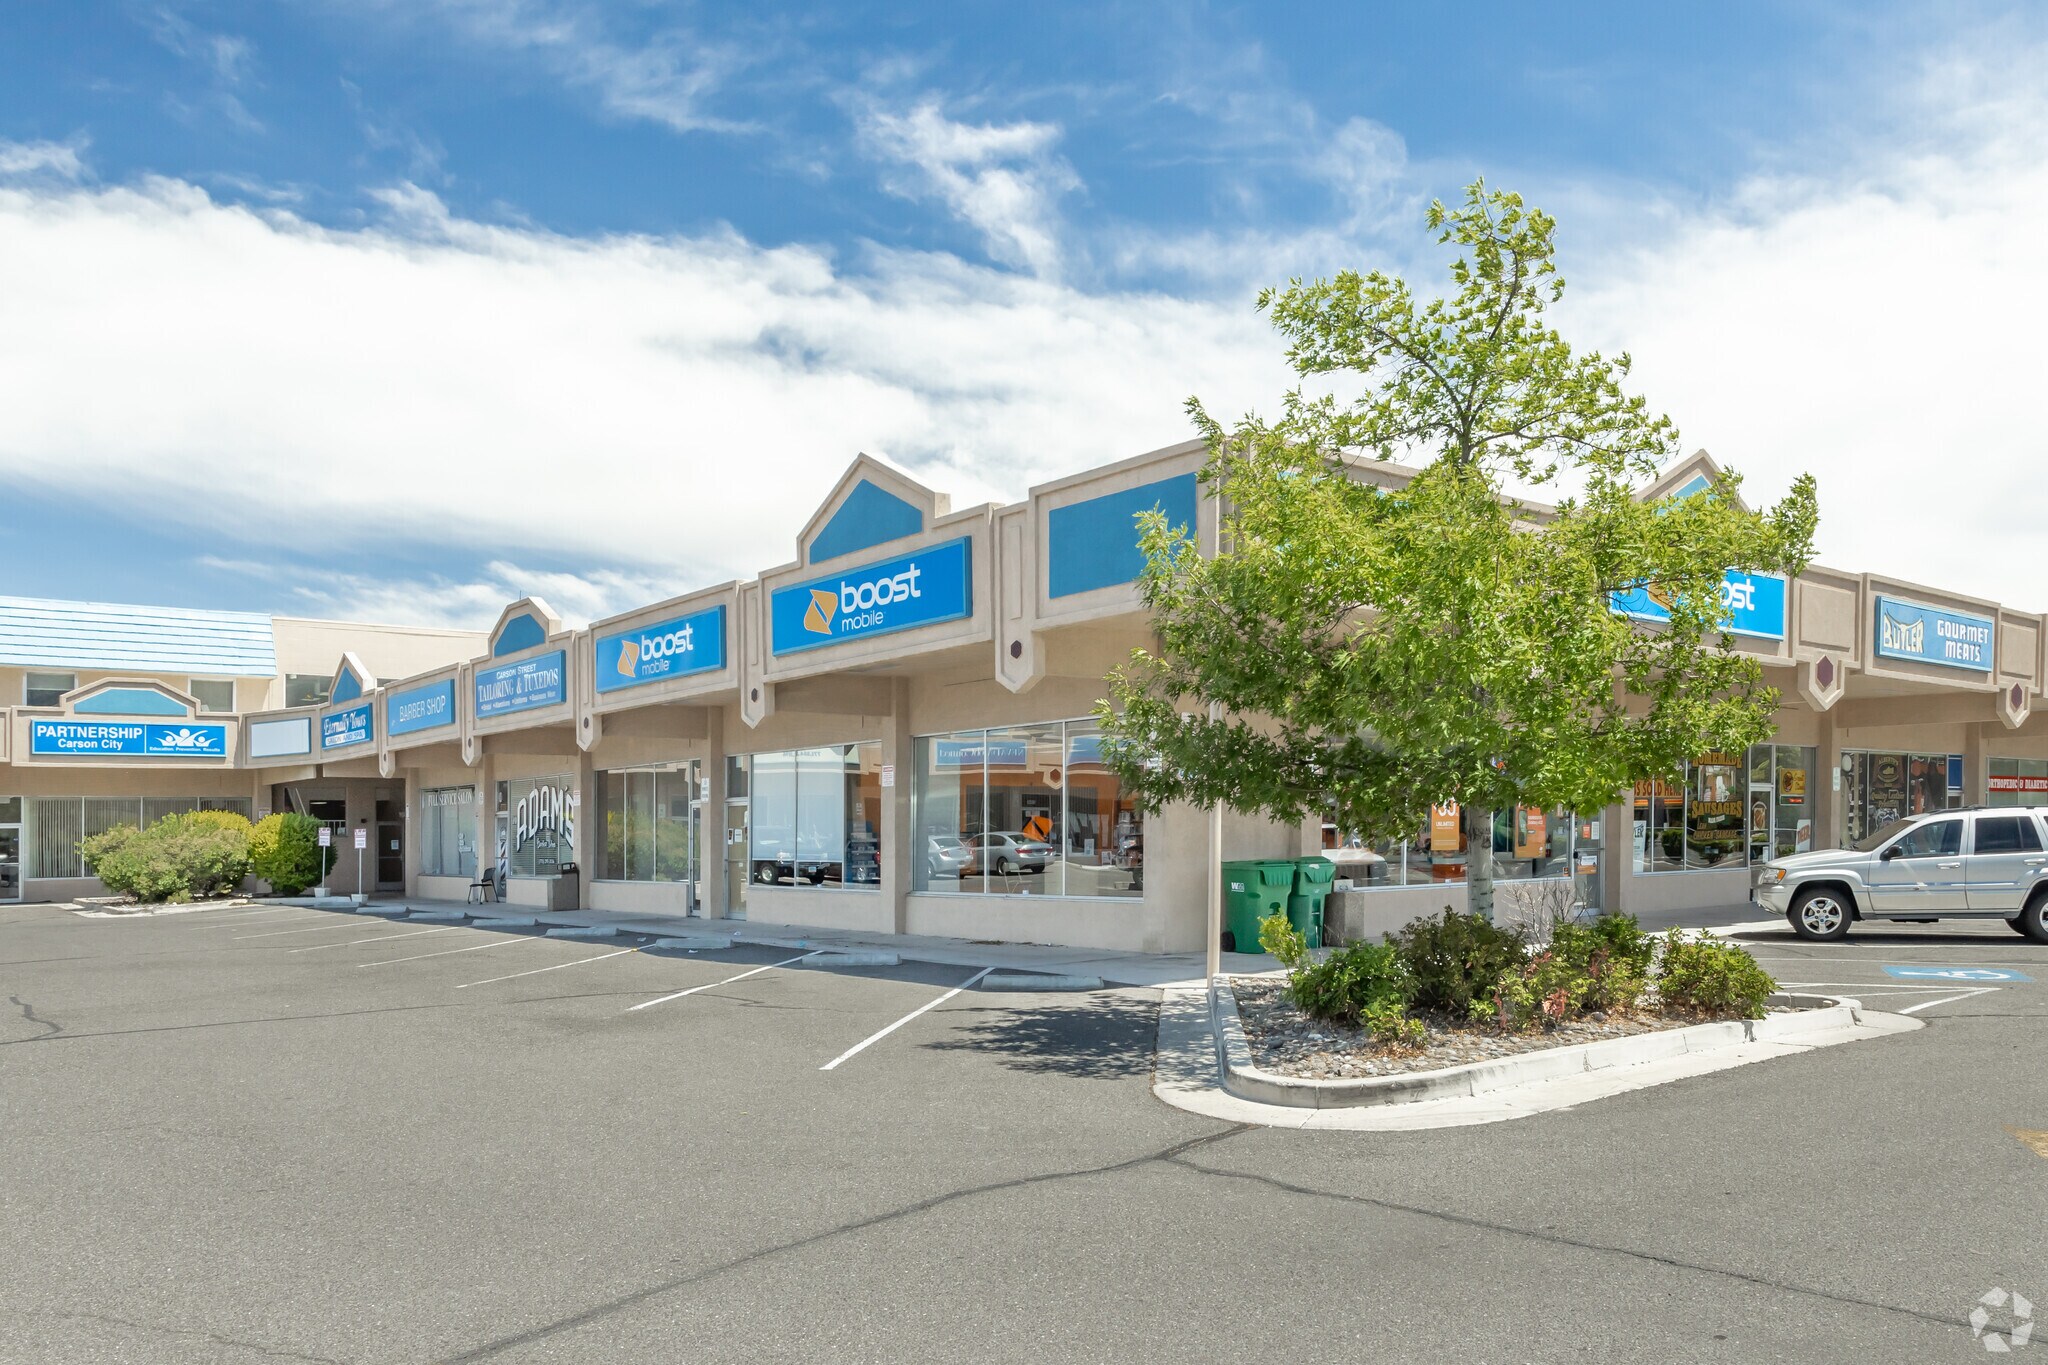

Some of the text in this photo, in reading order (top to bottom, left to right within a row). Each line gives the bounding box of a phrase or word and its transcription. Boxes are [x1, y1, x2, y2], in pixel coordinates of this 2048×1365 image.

[841, 563, 921, 613] boost
[841, 610, 884, 632] mobile
[1937, 619, 1989, 644] GOURMET
[641, 623, 694, 661] boost
[1883, 611, 1924, 654] BUTLER
[1945, 639, 1981, 662] MEATS
[496, 663, 537, 680] CARSON STREET
[642, 658, 670, 675] mobile
[478, 668, 559, 702] TAILORING & TUXEDOS
[399, 695, 446, 721] BARBER SHOP
[349, 712, 366, 729] Yours
[37, 725, 143, 739] PARTNERSHIP
[58, 738, 123, 750] Carson City
[1642, 780, 1662, 797] SOLD
[1691, 800, 1743, 818] SAUSAGES
